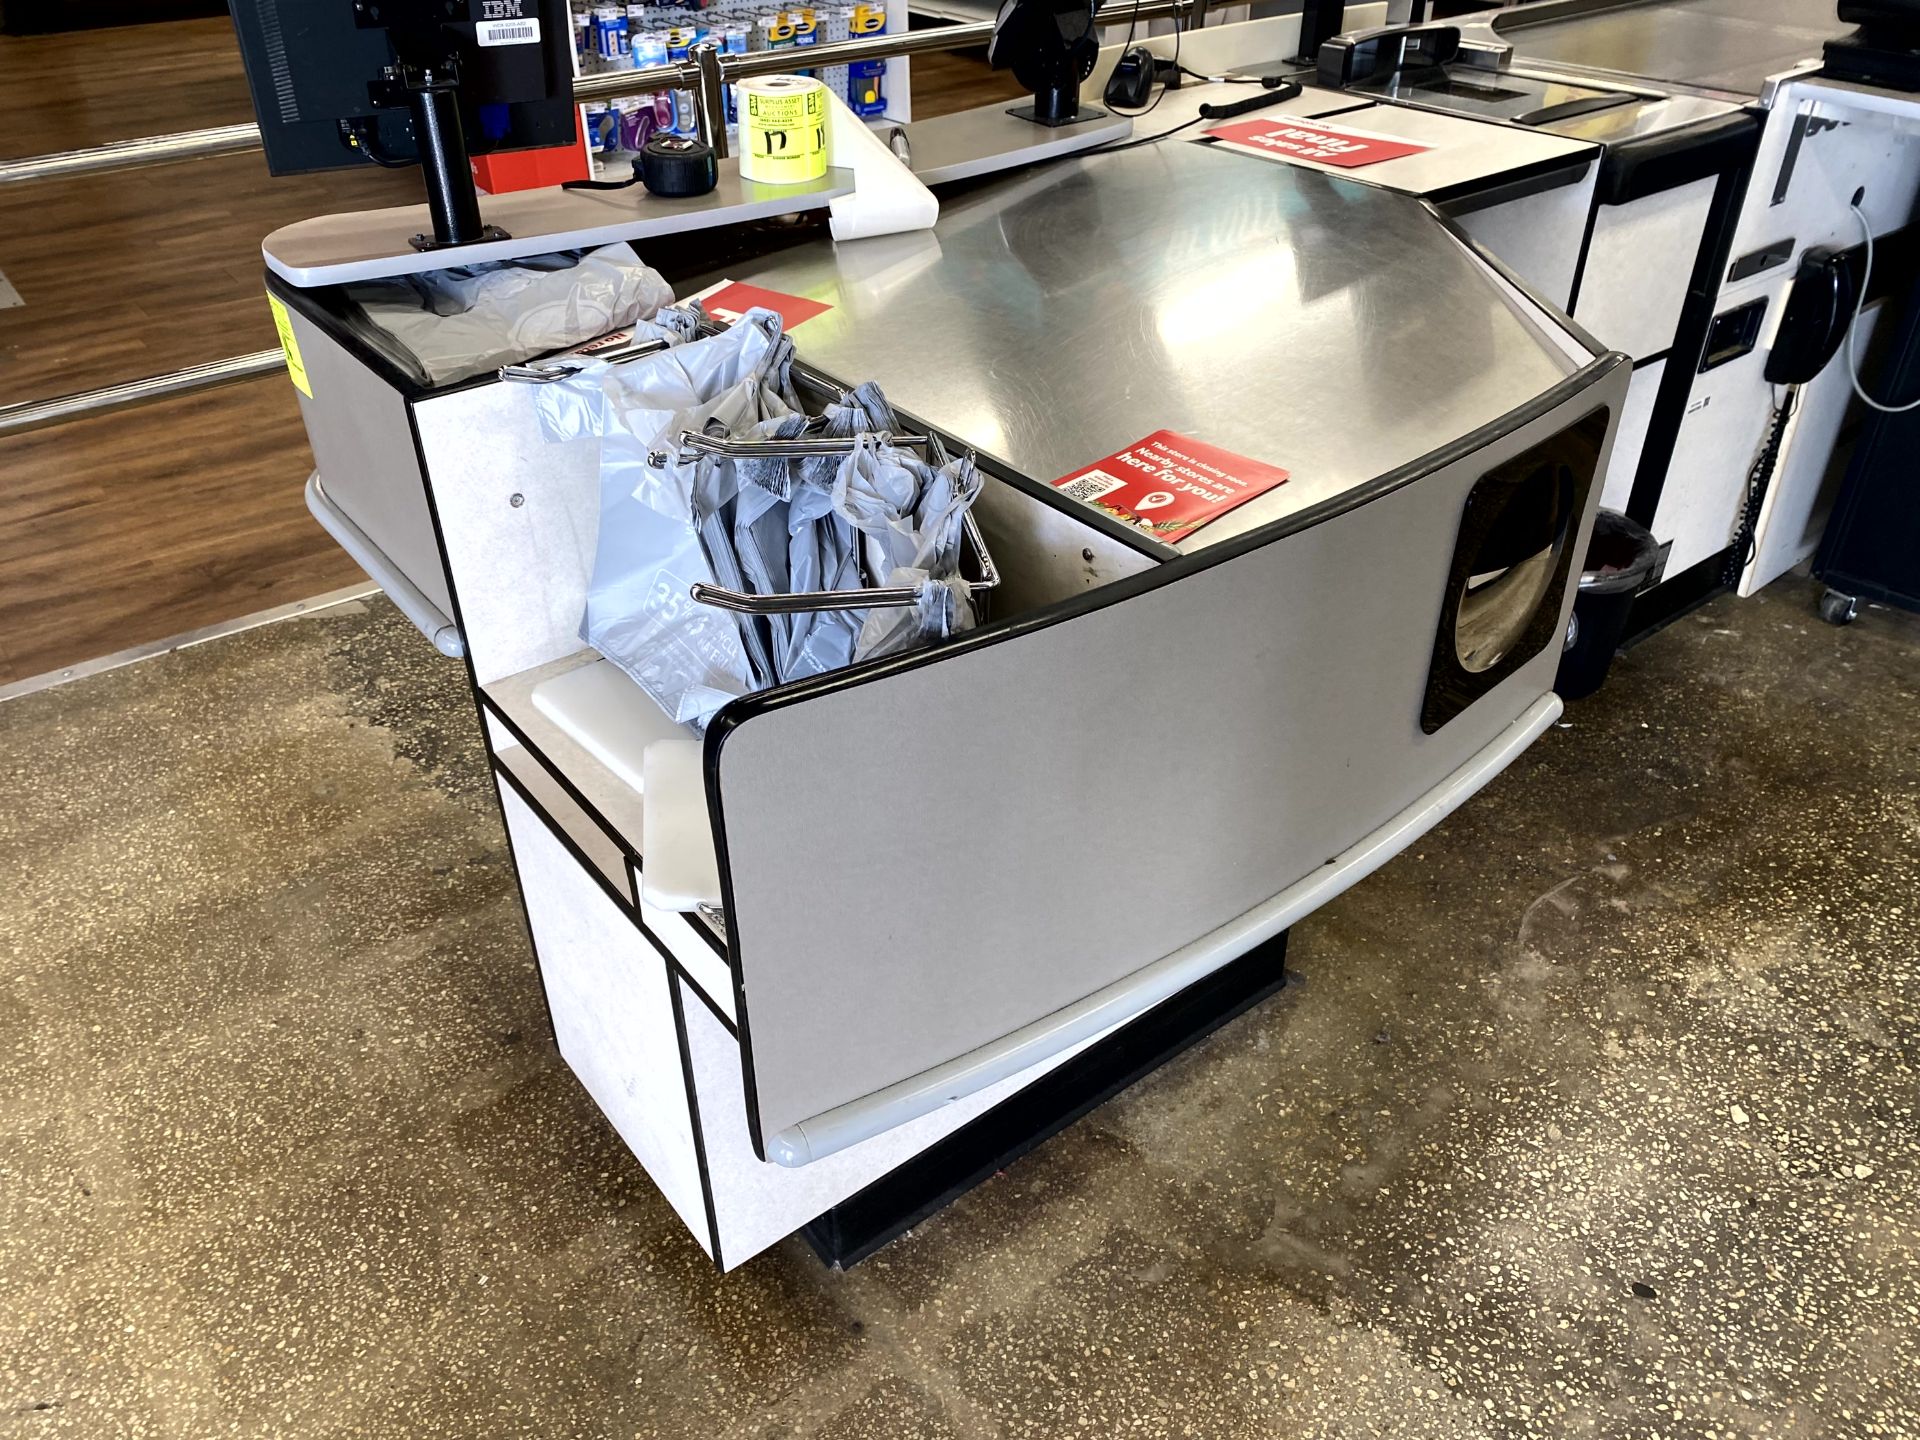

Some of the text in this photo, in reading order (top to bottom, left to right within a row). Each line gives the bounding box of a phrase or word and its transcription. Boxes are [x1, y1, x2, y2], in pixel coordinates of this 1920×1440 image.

[483, 0, 523, 19] IBM
[1247, 135, 1339, 157] All sales
[1265, 128, 1370, 153] Final
[1115, 451, 1228, 504] here for you!
[1134, 446, 1236, 495] Nearby stores are
[1150, 440, 1249, 488] This store is closing soon.
